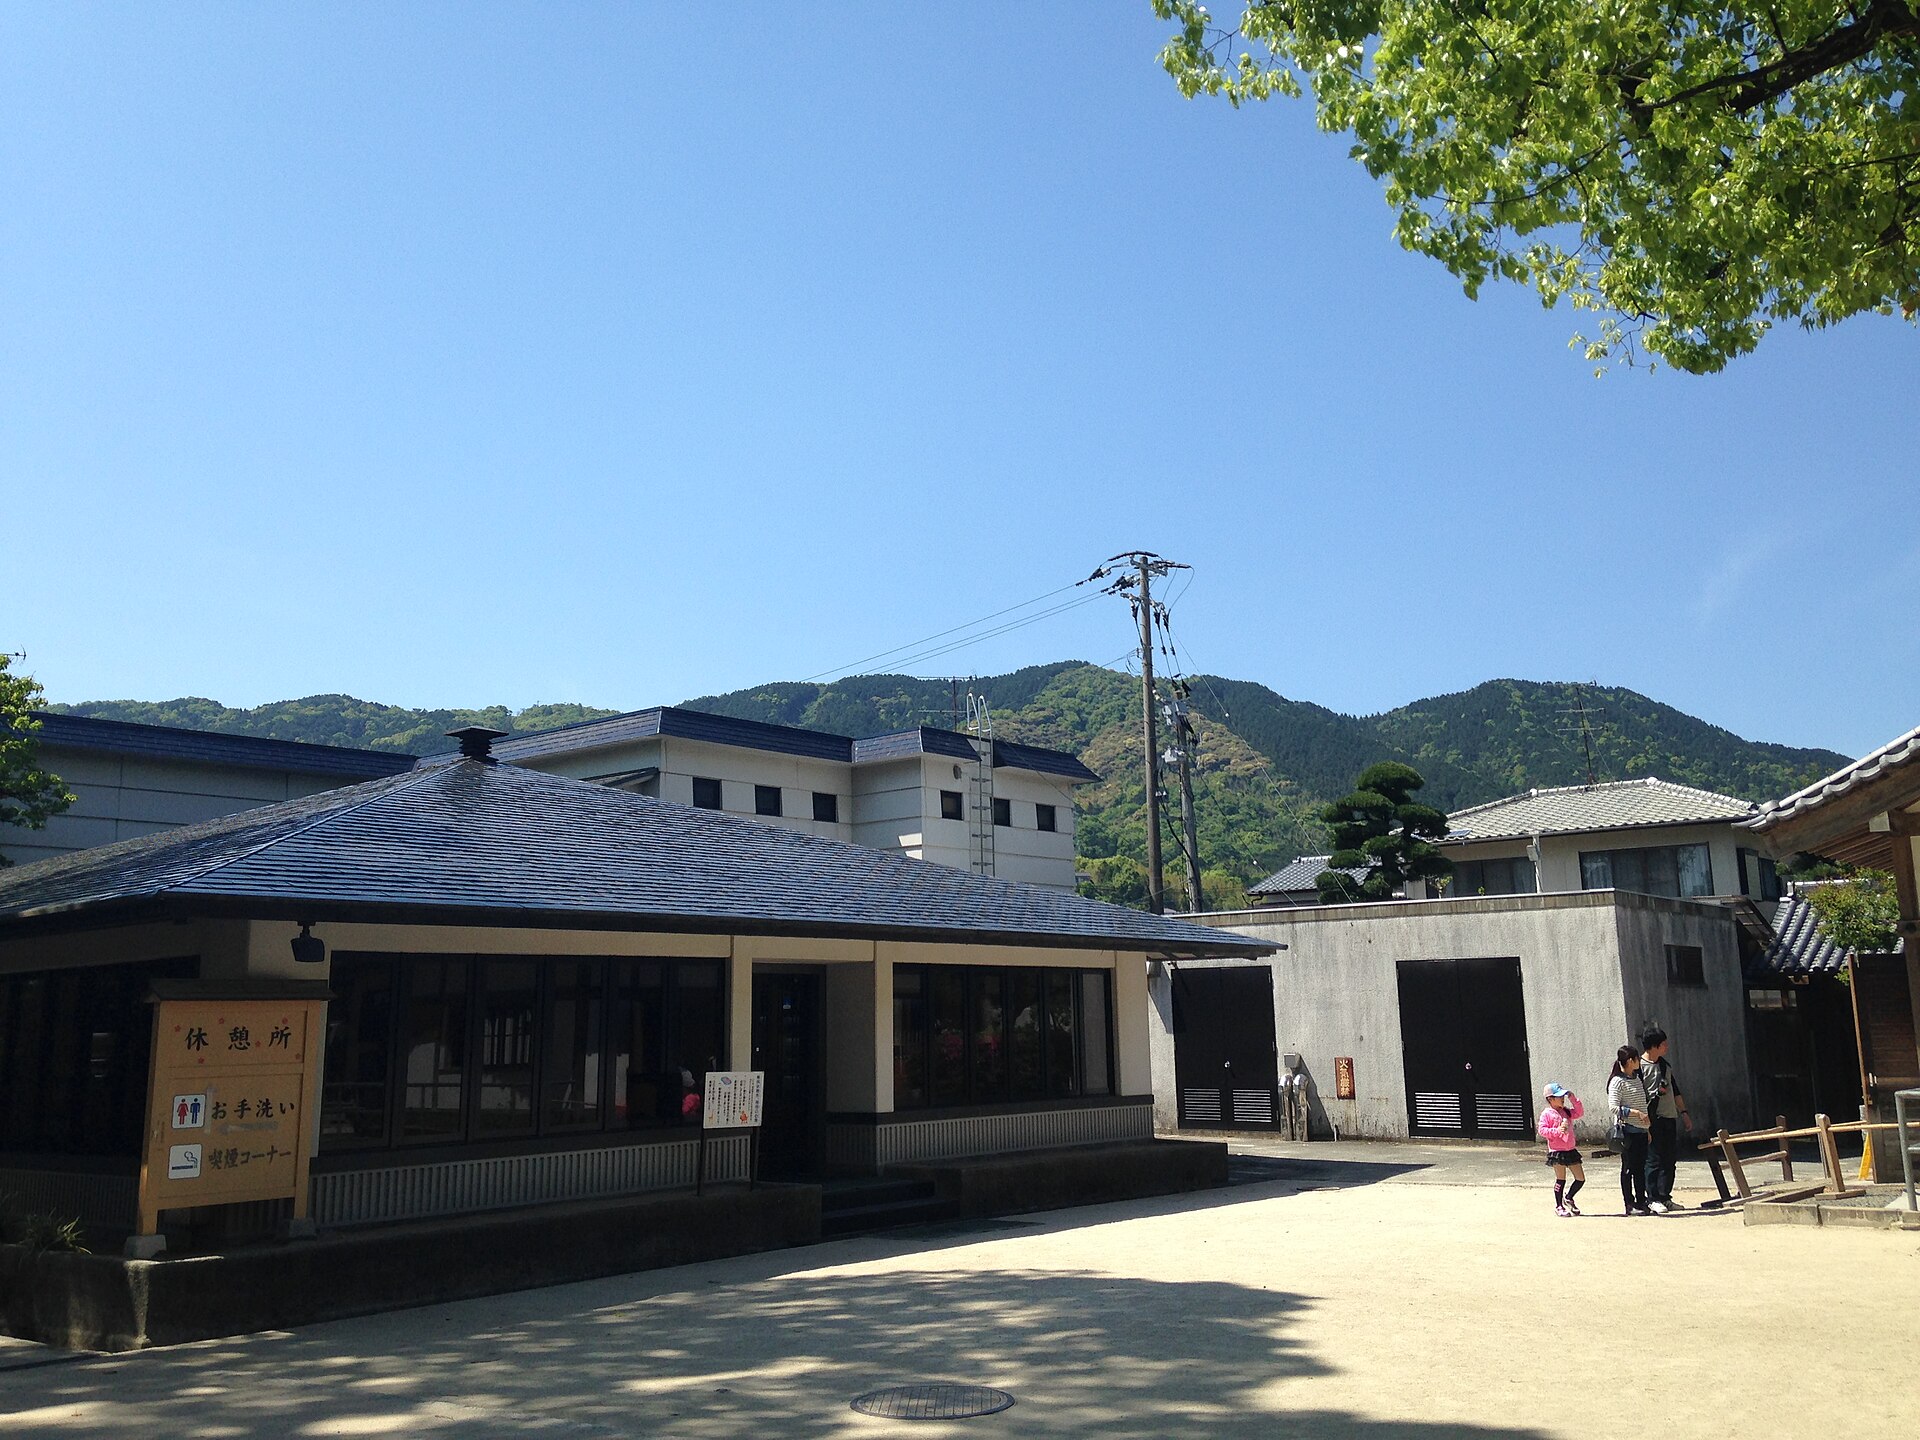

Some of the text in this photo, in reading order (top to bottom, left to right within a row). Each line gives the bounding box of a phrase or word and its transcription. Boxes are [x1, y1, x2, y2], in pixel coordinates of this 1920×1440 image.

[184, 1026, 292, 1051] 休憩所
[211, 1098, 295, 1120] お手洗い
[208, 1145, 292, 1170] 喫煙コーナー
